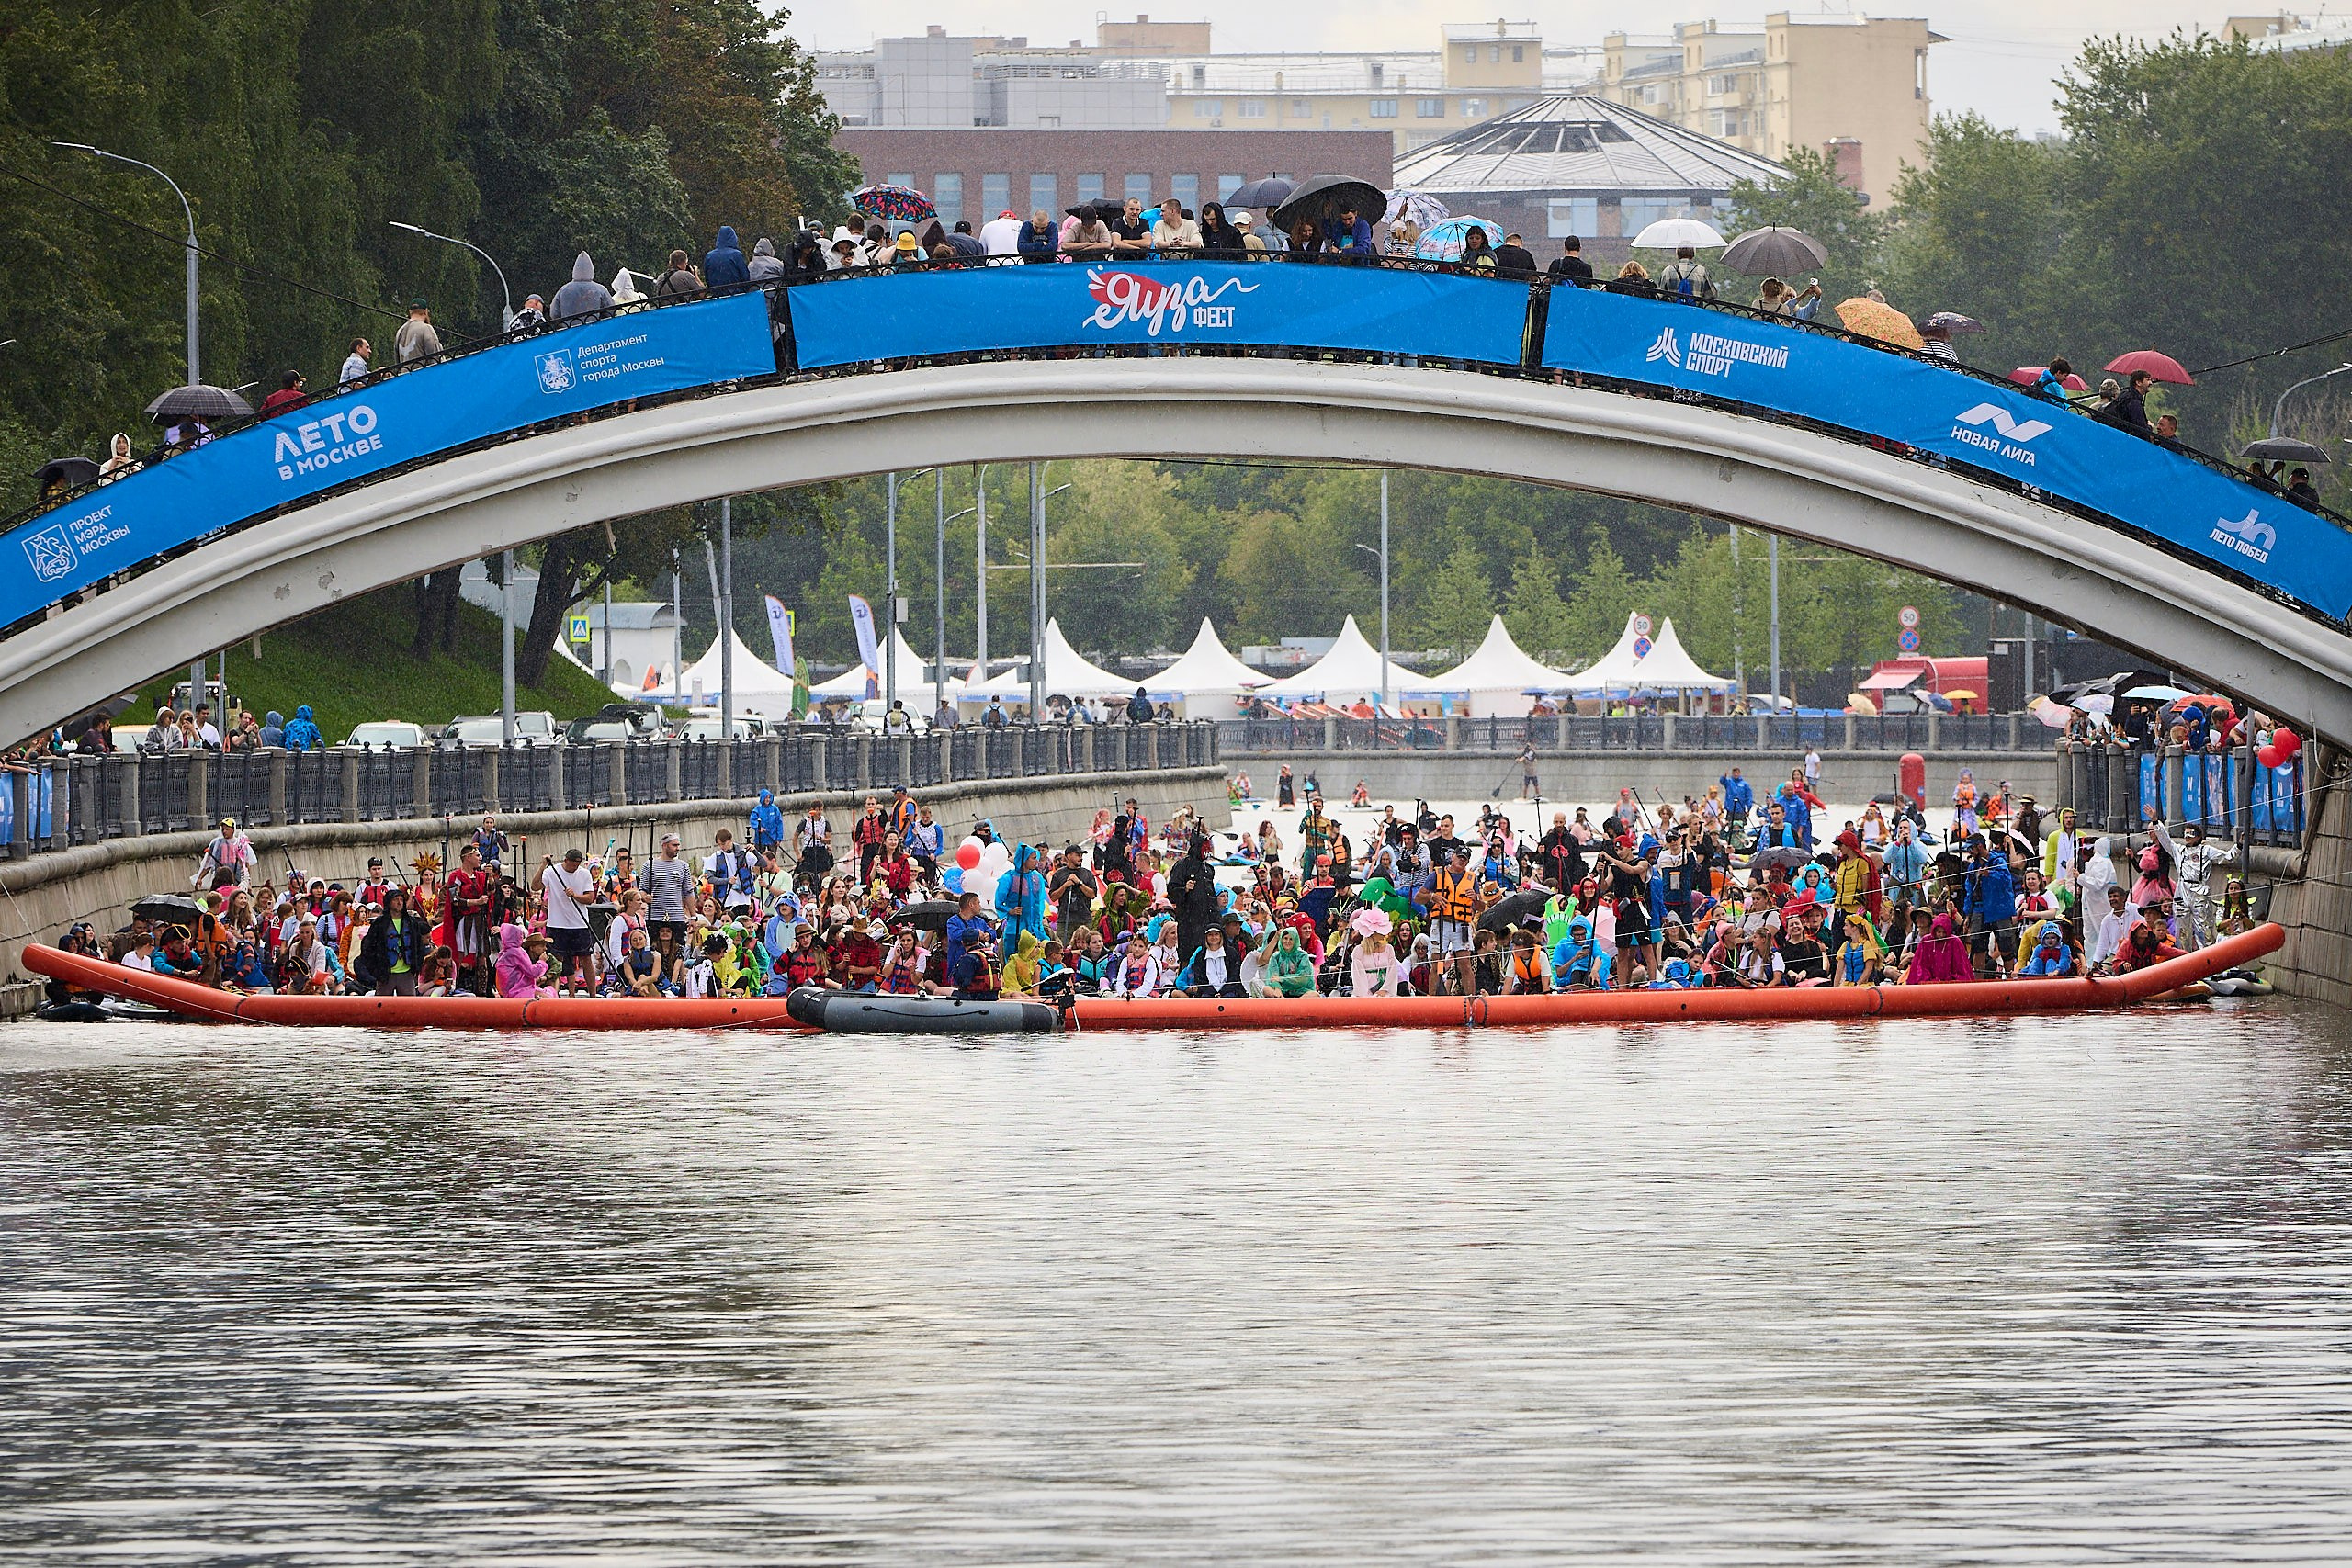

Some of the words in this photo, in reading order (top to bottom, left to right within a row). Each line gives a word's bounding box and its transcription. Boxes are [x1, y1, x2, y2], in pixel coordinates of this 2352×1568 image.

[1082, 273, 1261, 337] Яуза
[1193, 306, 1236, 328] ФЕСТ
[577, 333, 648, 359] Департамент
[1689, 332, 1789, 369] МОСКОВСКИЙ
[580, 353, 617, 370] спорта
[582, 367, 620, 383] города
[622, 356, 664, 373] Москвы
[1685, 351, 1735, 378] СПОРТ
[275, 404, 378, 464] ЛЕТО
[1951, 425, 2000, 453] НОВАЯ
[2000, 444, 2035, 467] ЛИГА
[277, 465, 294, 481] В
[297, 434, 384, 475] МОСКВЕ
[69, 504, 112, 533] ПРОЕКТ
[74, 523, 108, 545] МЭРА
[79, 525, 130, 556] МОСКВЫ
[2209, 528, 2236, 548] ЛЕТО
[2234, 539, 2269, 564] ПОБЕД
[1636, 621, 1649, 630] 50
[1903, 613, 1916, 623] 50
